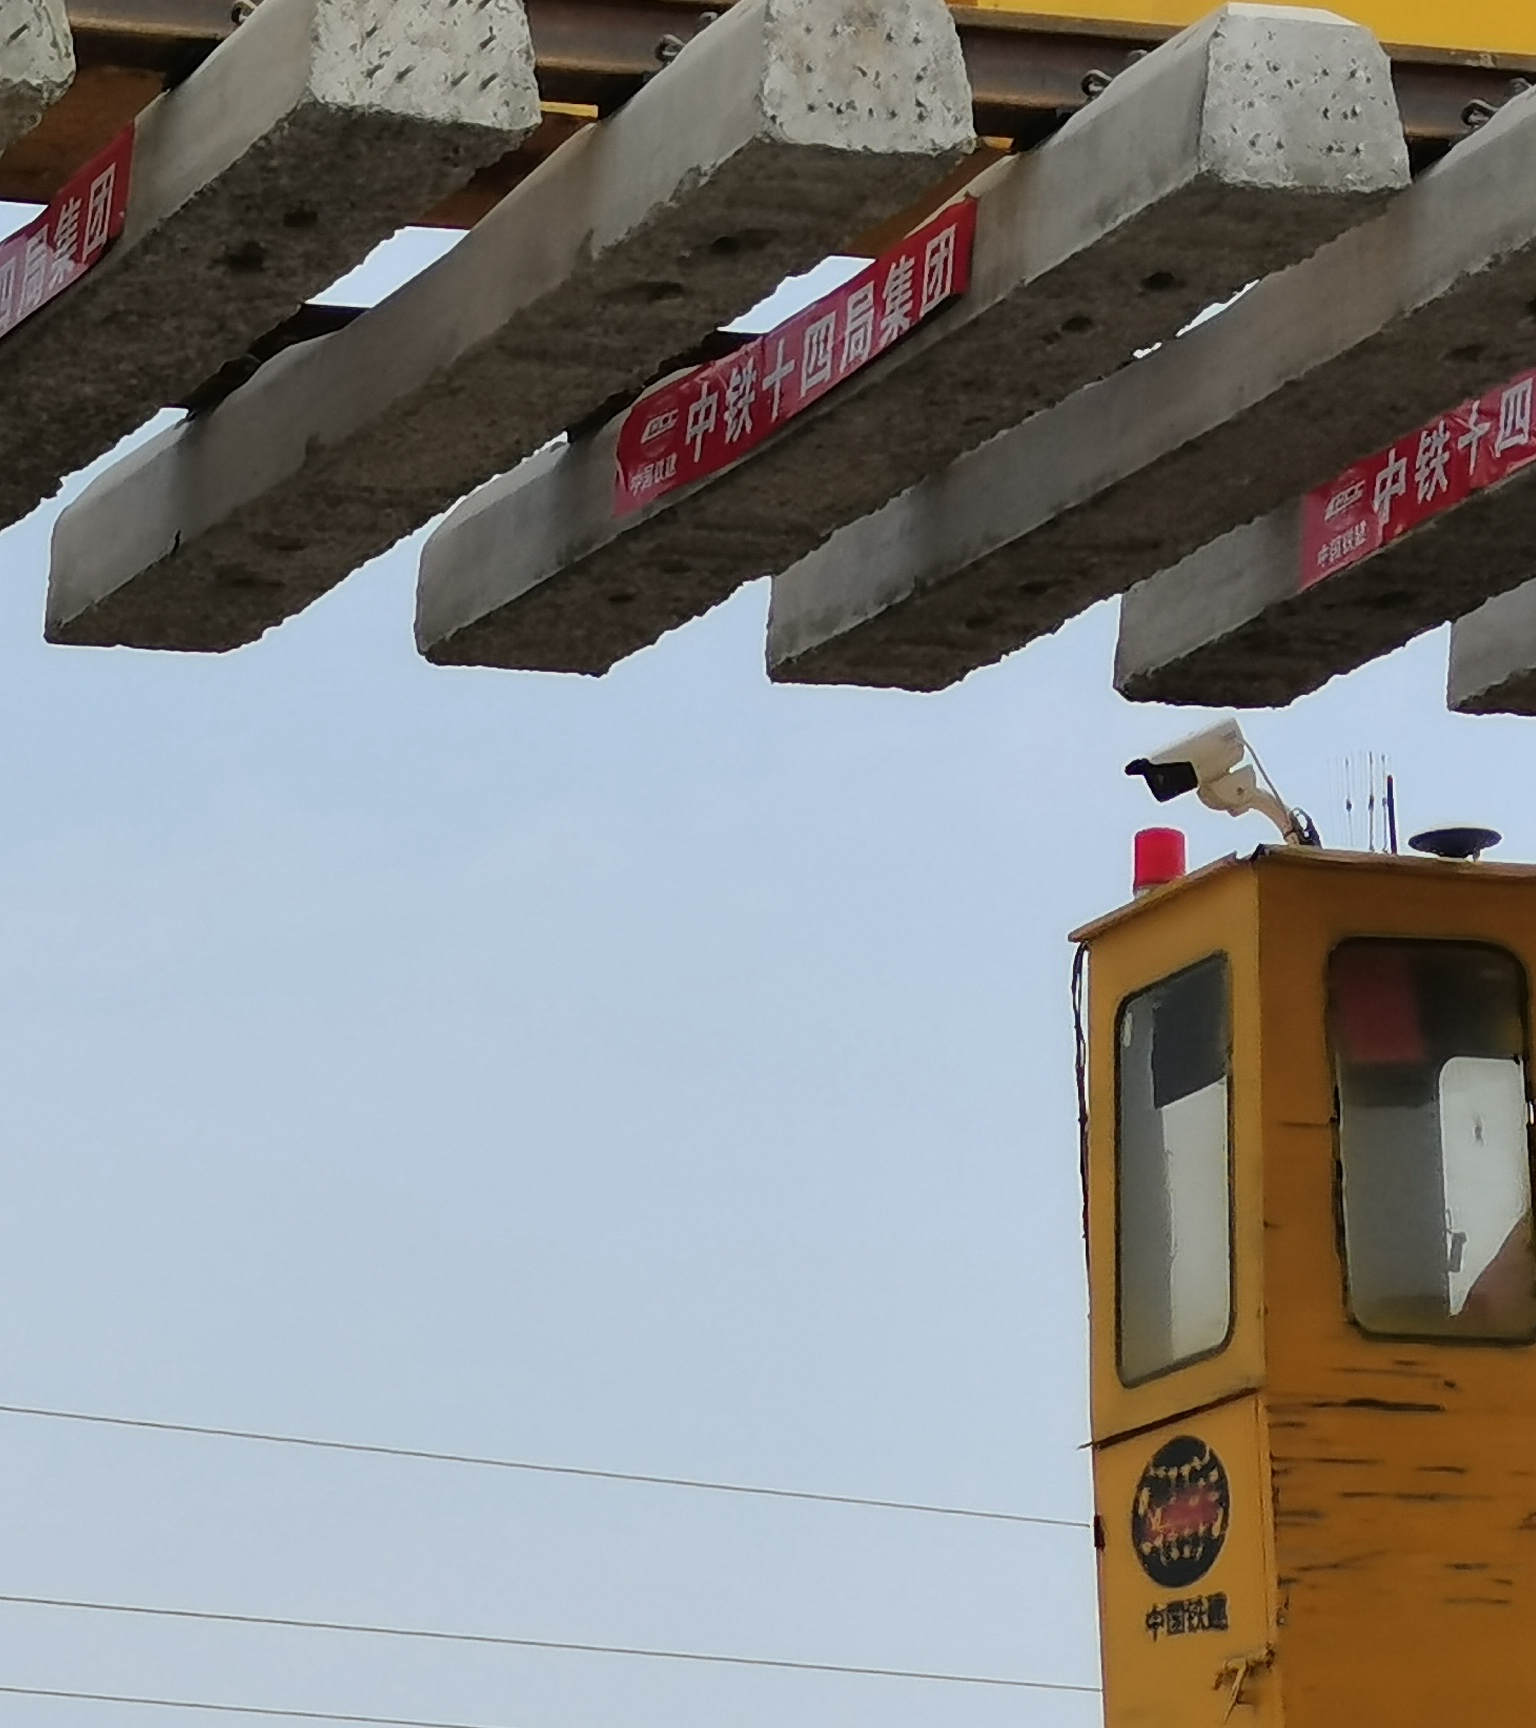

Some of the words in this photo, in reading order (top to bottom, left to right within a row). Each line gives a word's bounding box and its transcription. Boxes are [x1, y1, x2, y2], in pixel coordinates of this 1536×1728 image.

[684, 222, 958, 463] 中铁十四局集团
[1145, 1592, 1229, 1643] 中国铁
